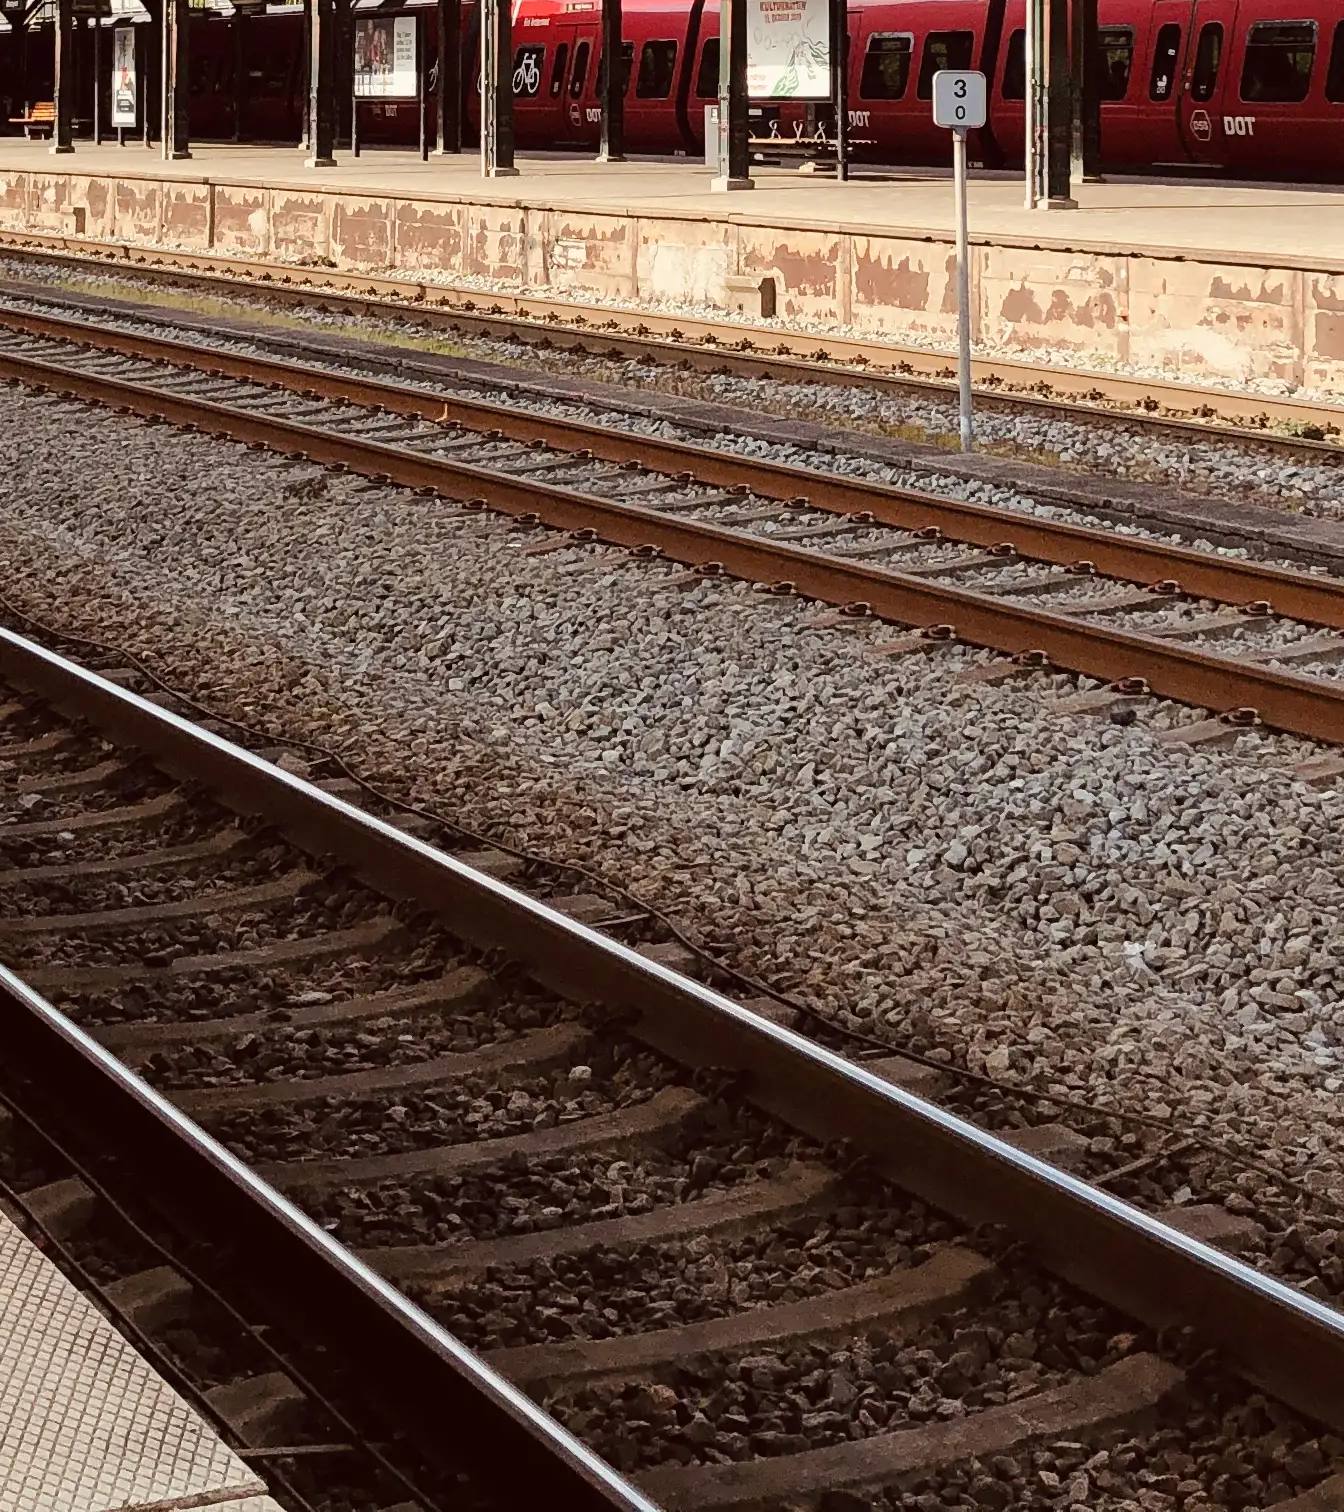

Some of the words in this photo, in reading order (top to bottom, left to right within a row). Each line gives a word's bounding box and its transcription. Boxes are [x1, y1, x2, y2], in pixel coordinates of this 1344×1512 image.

[954, 79, 967, 98] 3
[847, 110, 871, 127] DOT
[955, 105, 966, 120] 0
[1223, 115, 1256, 136] DOT
